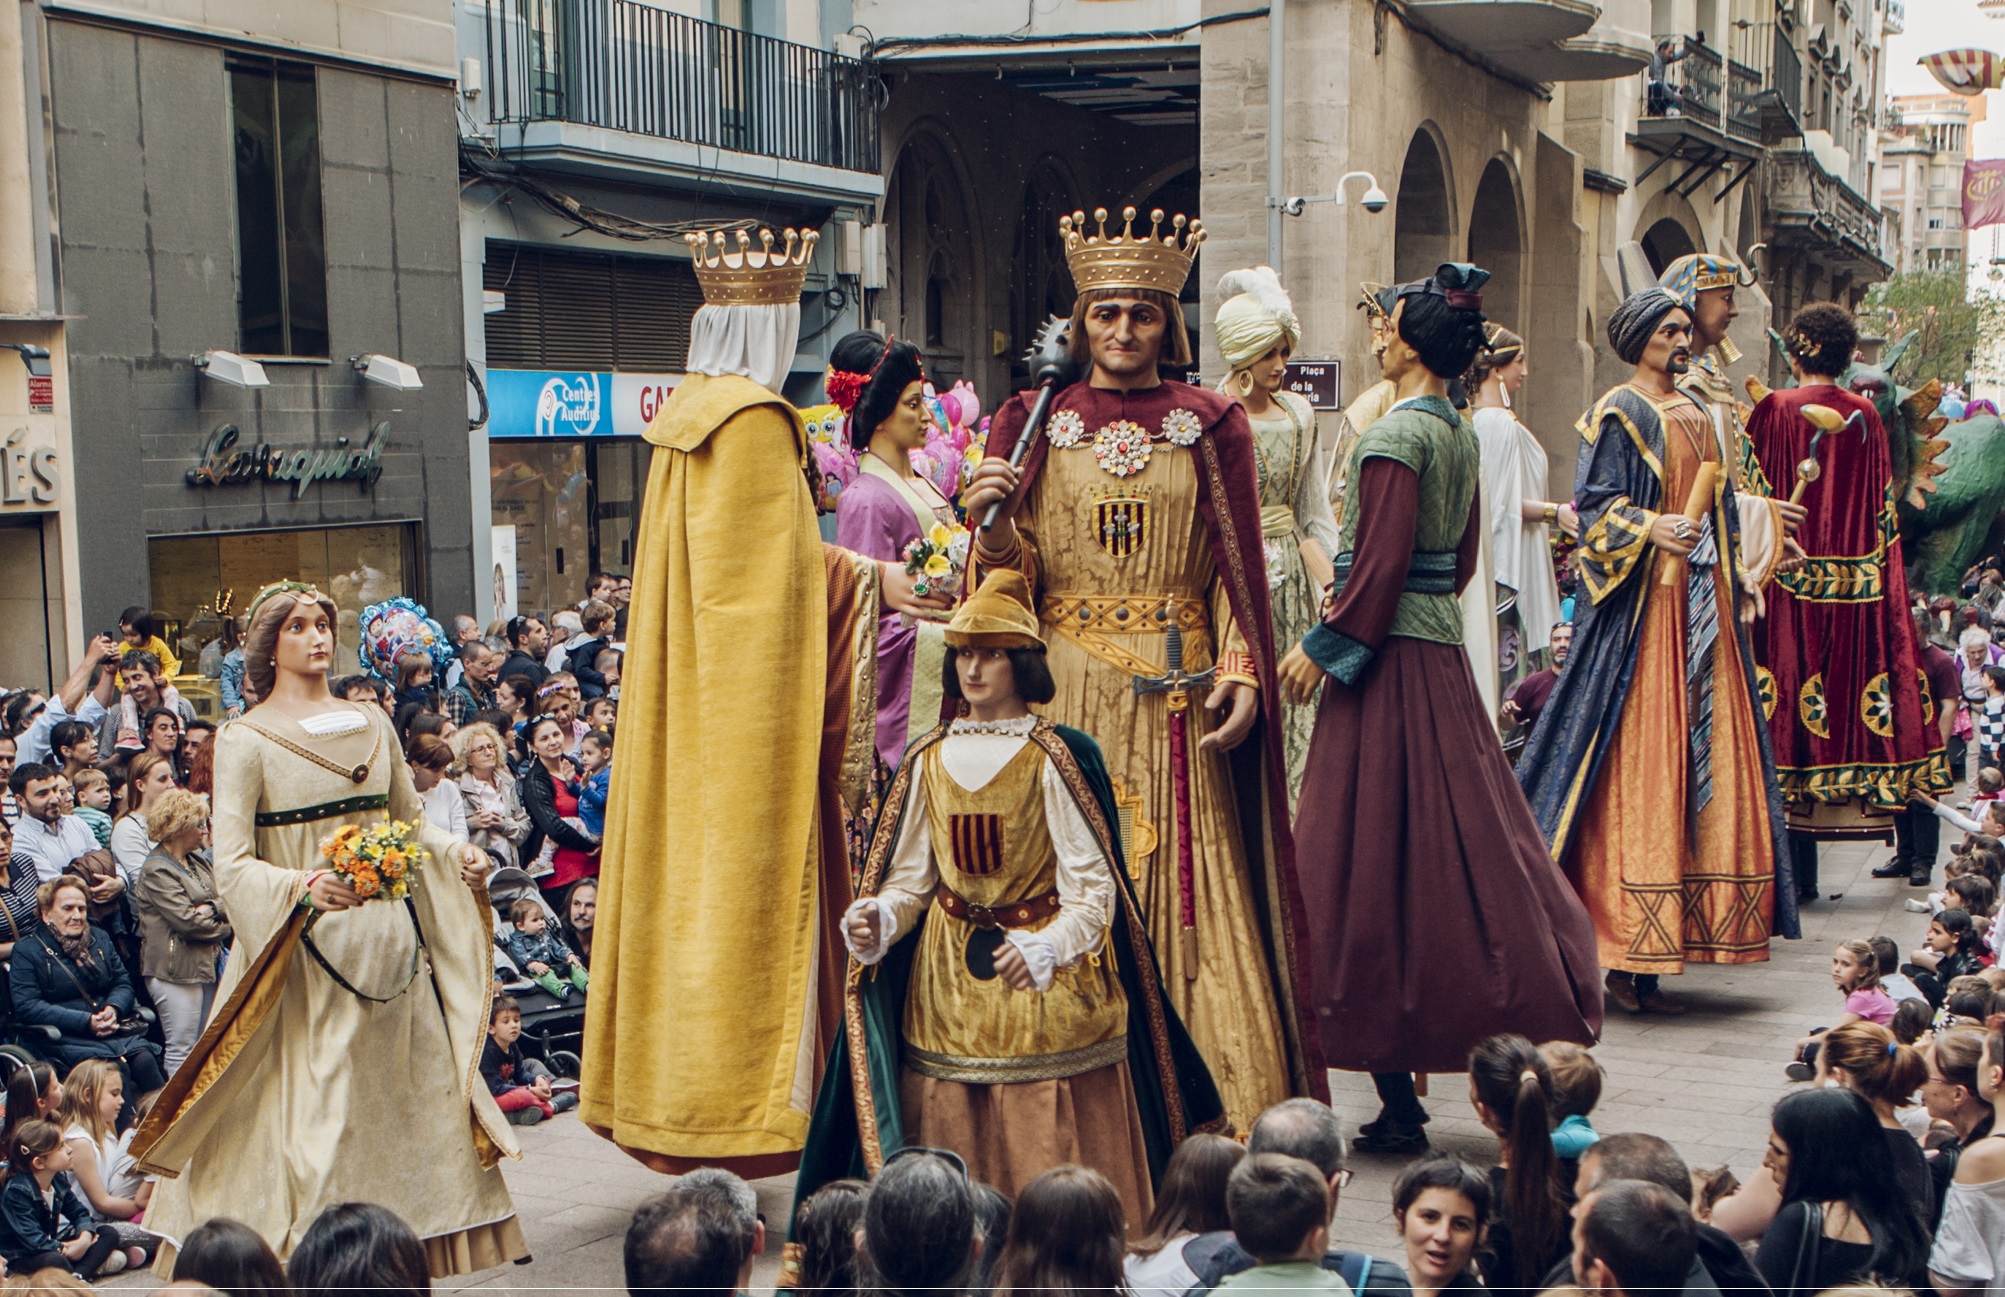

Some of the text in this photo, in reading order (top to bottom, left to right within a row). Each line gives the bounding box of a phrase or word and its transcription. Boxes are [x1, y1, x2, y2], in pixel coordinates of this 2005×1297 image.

[1300, 366, 1325, 376] Plaça
[1290, 381, 1313, 392] de la
[640, 386, 675, 424] GA
